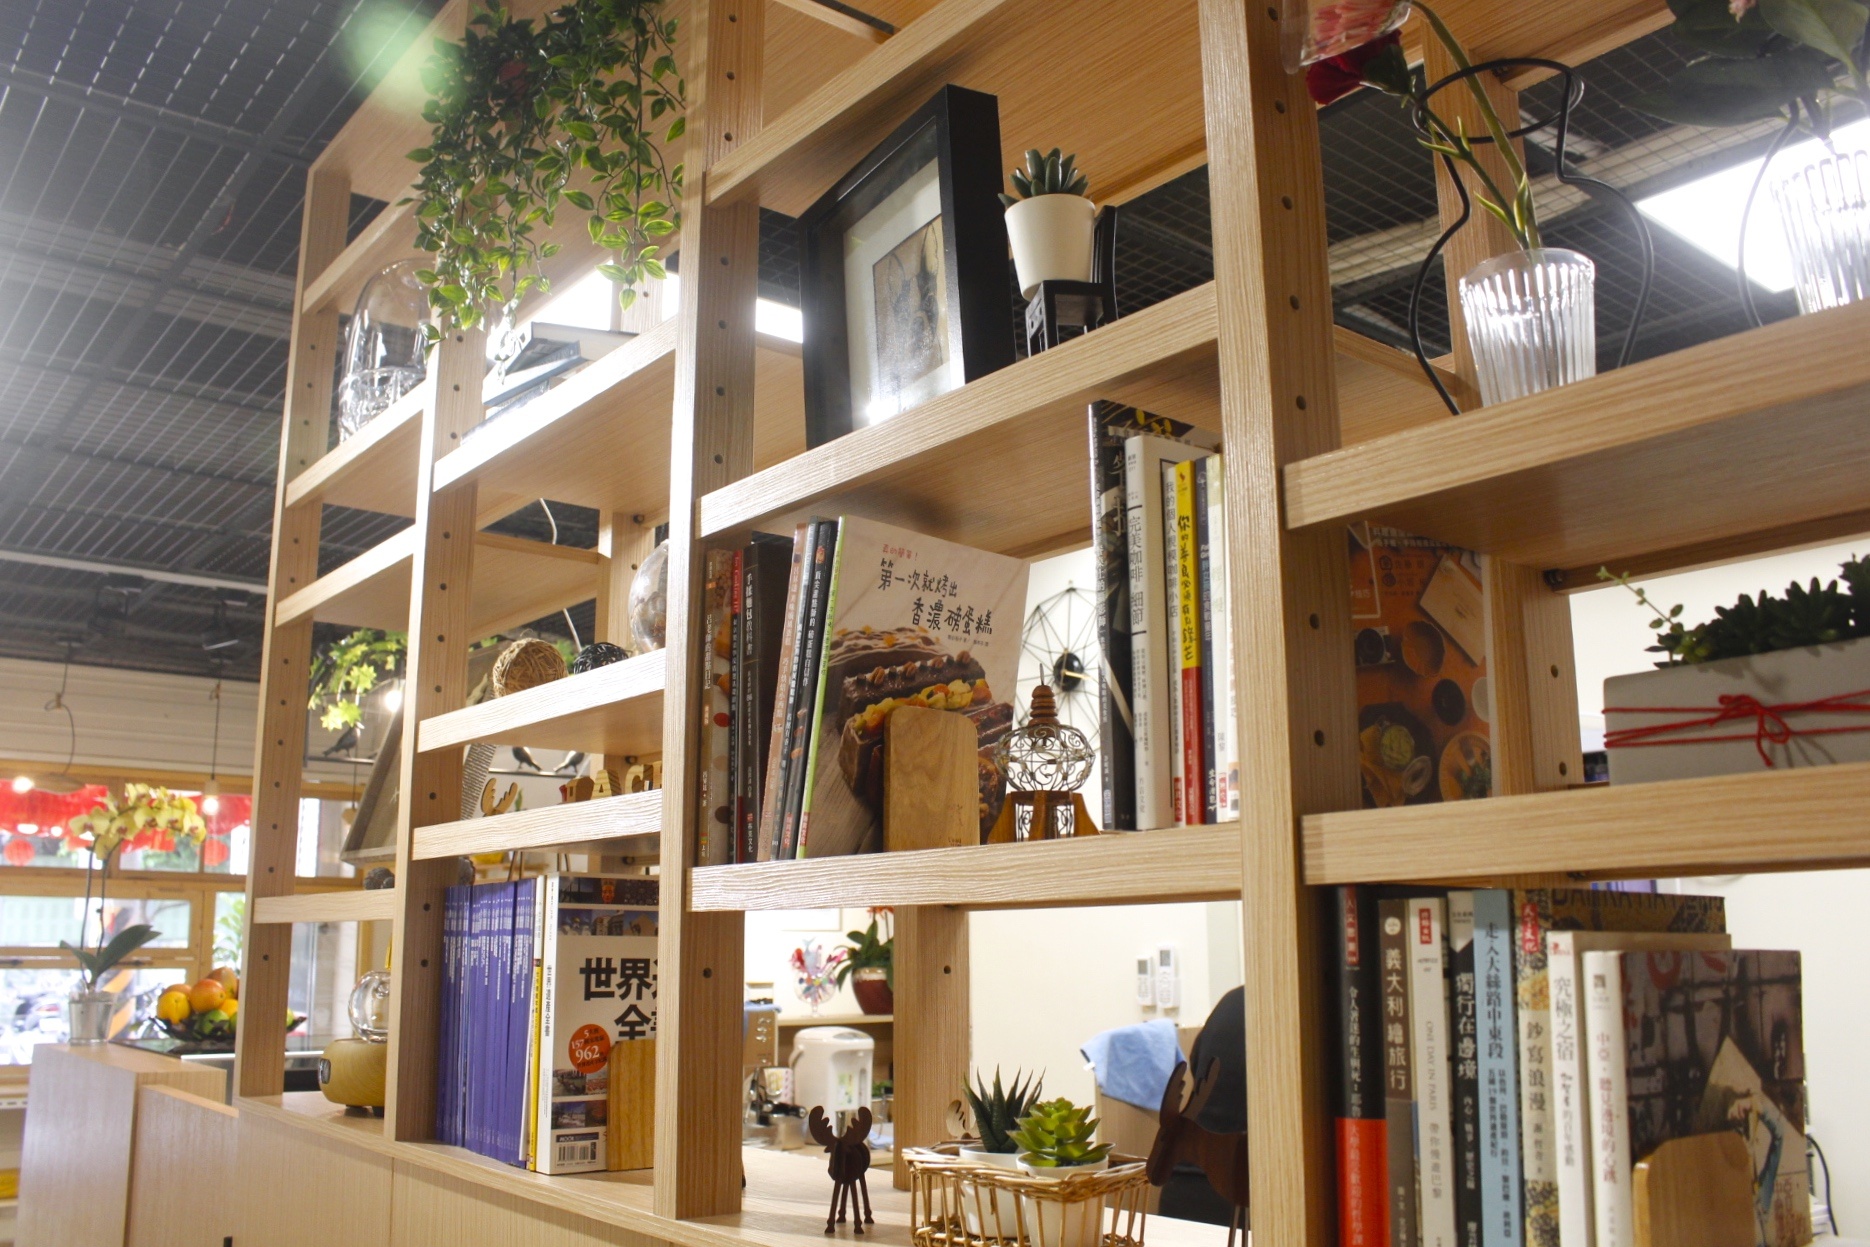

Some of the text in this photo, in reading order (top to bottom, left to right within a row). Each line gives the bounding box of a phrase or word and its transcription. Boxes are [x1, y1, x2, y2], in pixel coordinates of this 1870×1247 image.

[878, 558, 957, 598] 第一次就烤出
[912, 597, 992, 635] 香濃磅蛋糕
[579, 957, 657, 1001] 世界
[614, 1004, 657, 1040] 全
[1385, 948, 1406, 1090] 義大利繪旅行
[576, 1045, 599, 1063] 962
